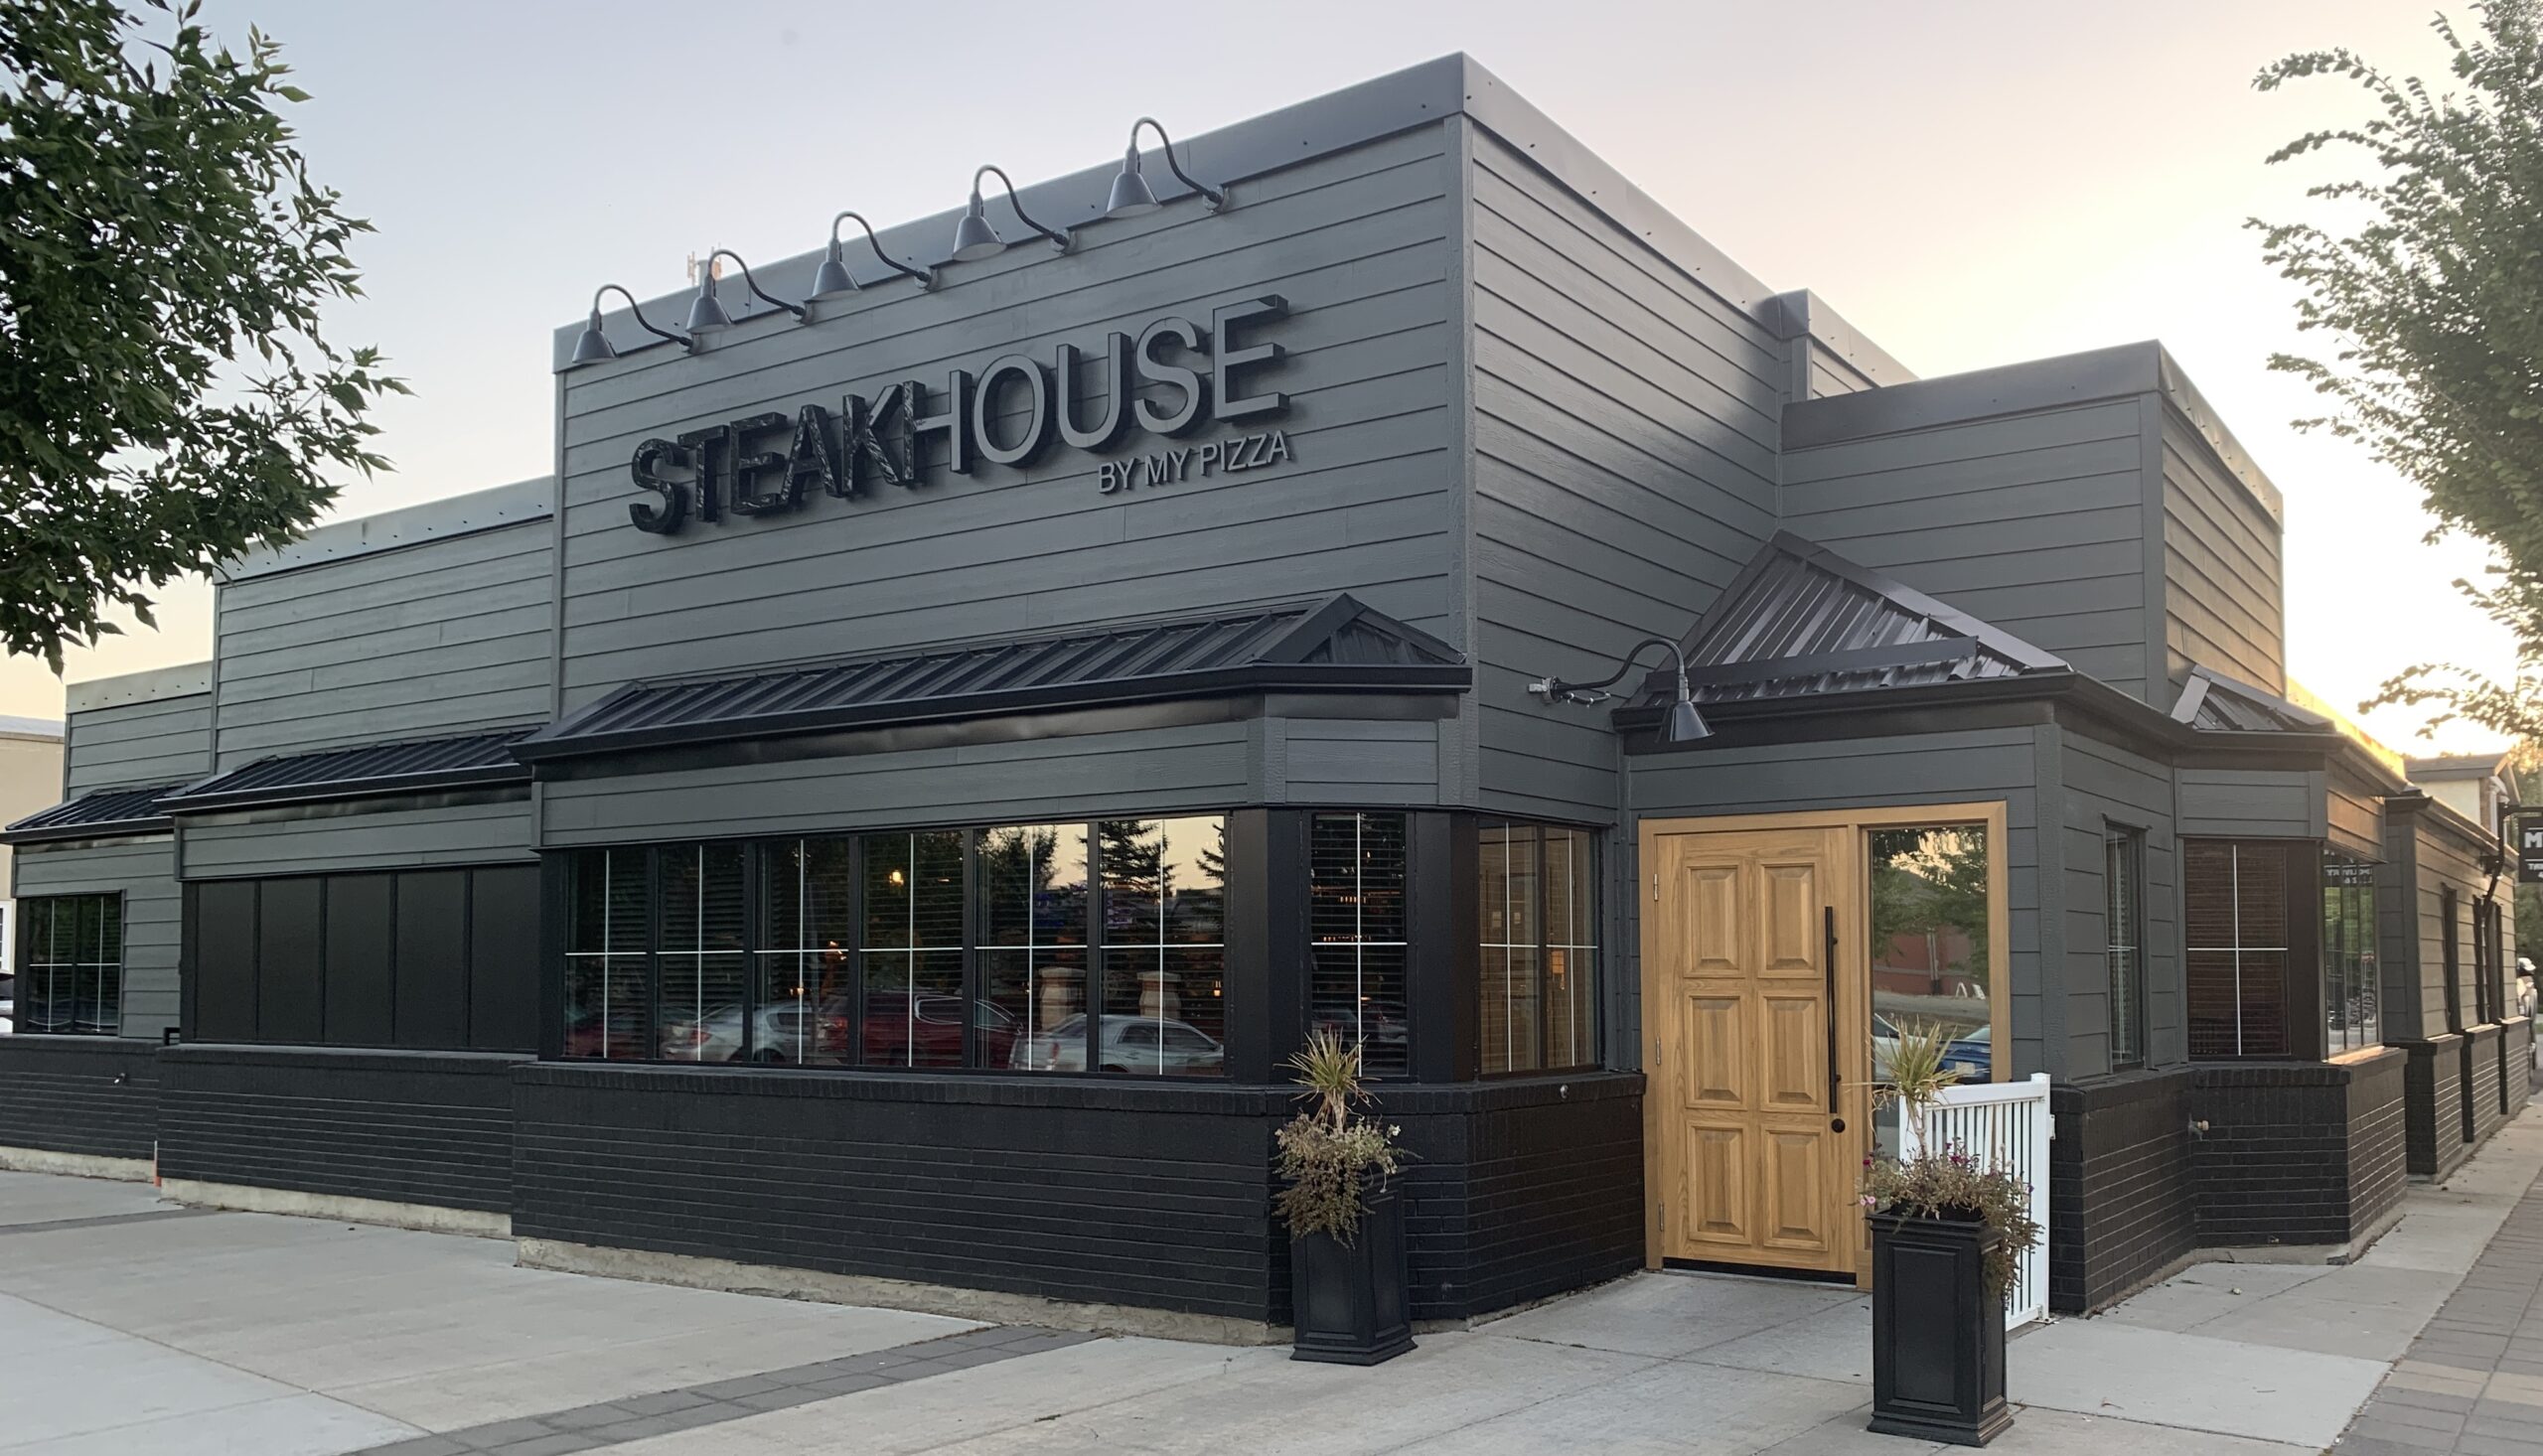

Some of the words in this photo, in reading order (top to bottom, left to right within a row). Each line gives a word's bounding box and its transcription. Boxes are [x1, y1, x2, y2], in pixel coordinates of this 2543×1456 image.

[630, 294, 1289, 534] STEAKHOUSE
[1099, 458, 1138, 494] BY
[1144, 448, 1192, 486] MY
[1200, 430, 1290, 476] PIZZA
[2524, 831, 2543, 848] M
